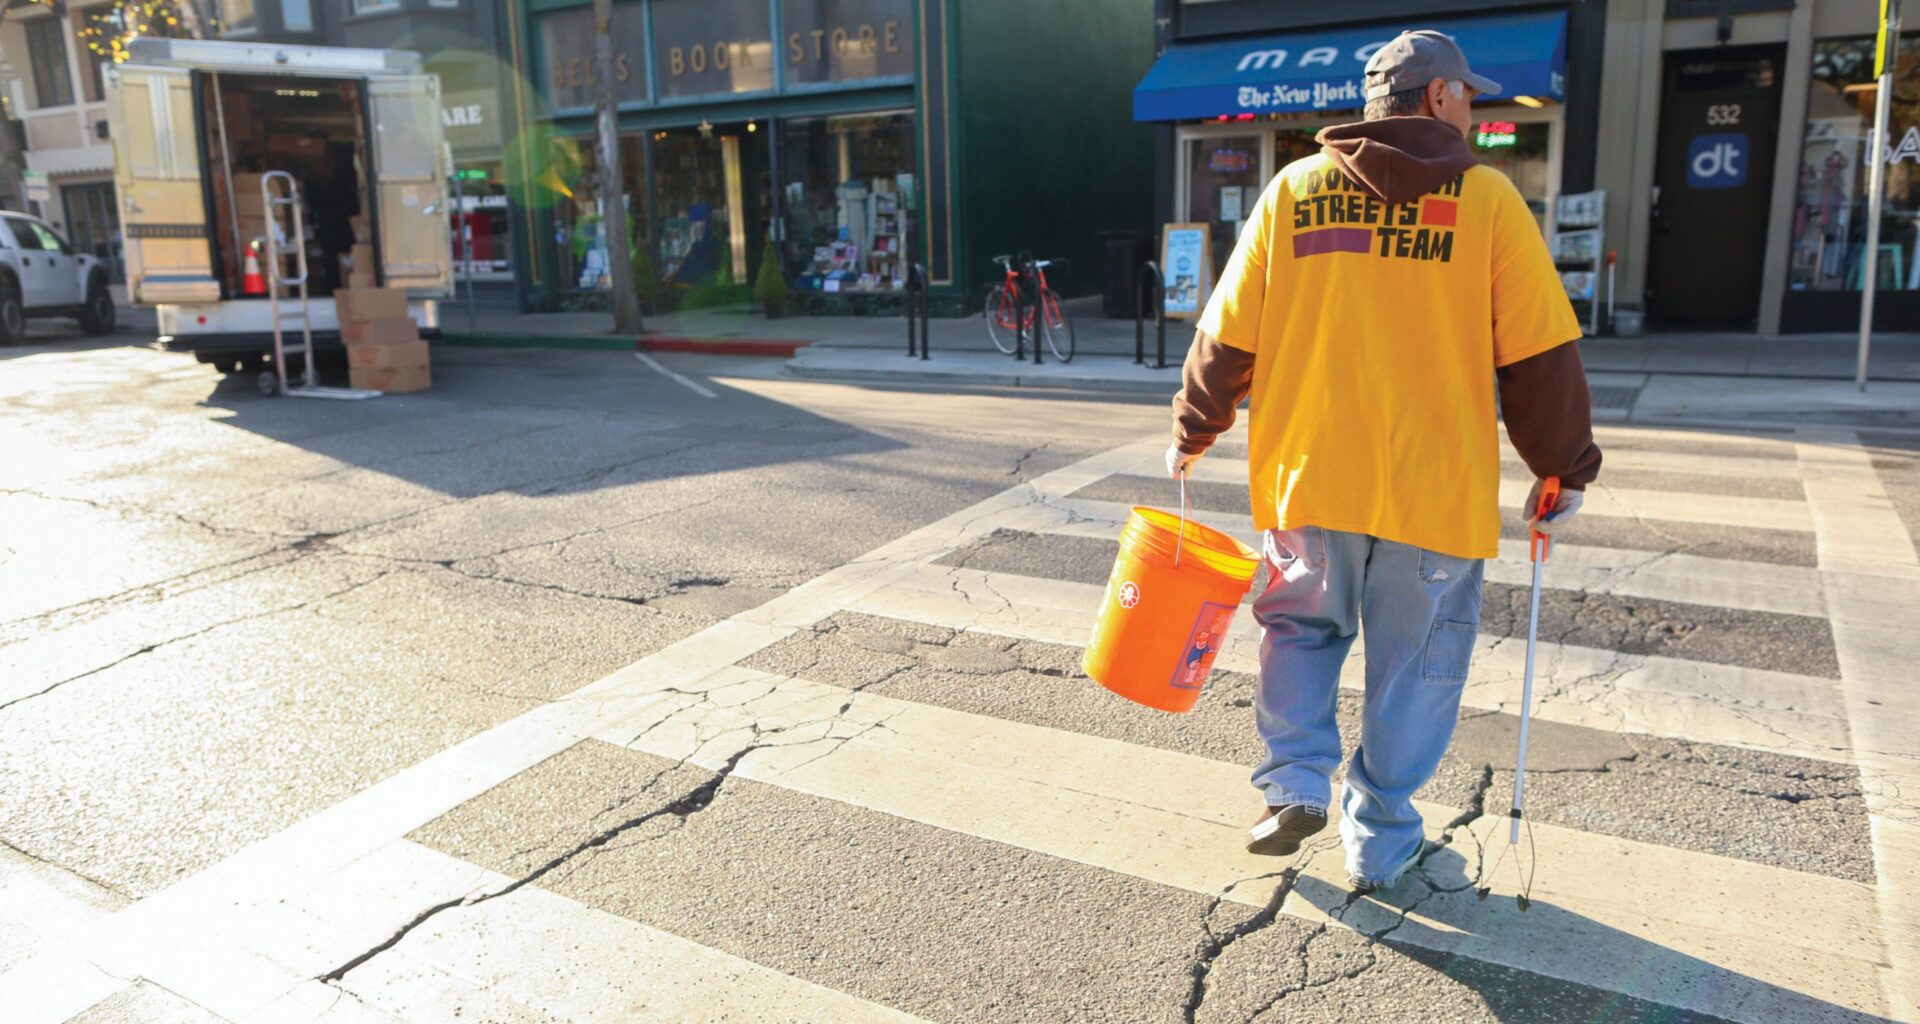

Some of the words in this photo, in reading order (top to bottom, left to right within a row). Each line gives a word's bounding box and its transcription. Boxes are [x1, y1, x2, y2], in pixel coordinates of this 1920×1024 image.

[670, 37, 752, 76] BOOK
[789, 20, 900, 63] STORE
[1238, 86, 1271, 108] The
[1272, 84, 1311, 106] New
[1313, 80, 1359, 108] York
[1707, 104, 1741, 126] 532
[1692, 142, 1741, 178] dt
[1294, 194, 1419, 229] STREETS
[1377, 227, 1454, 262] TEAM
